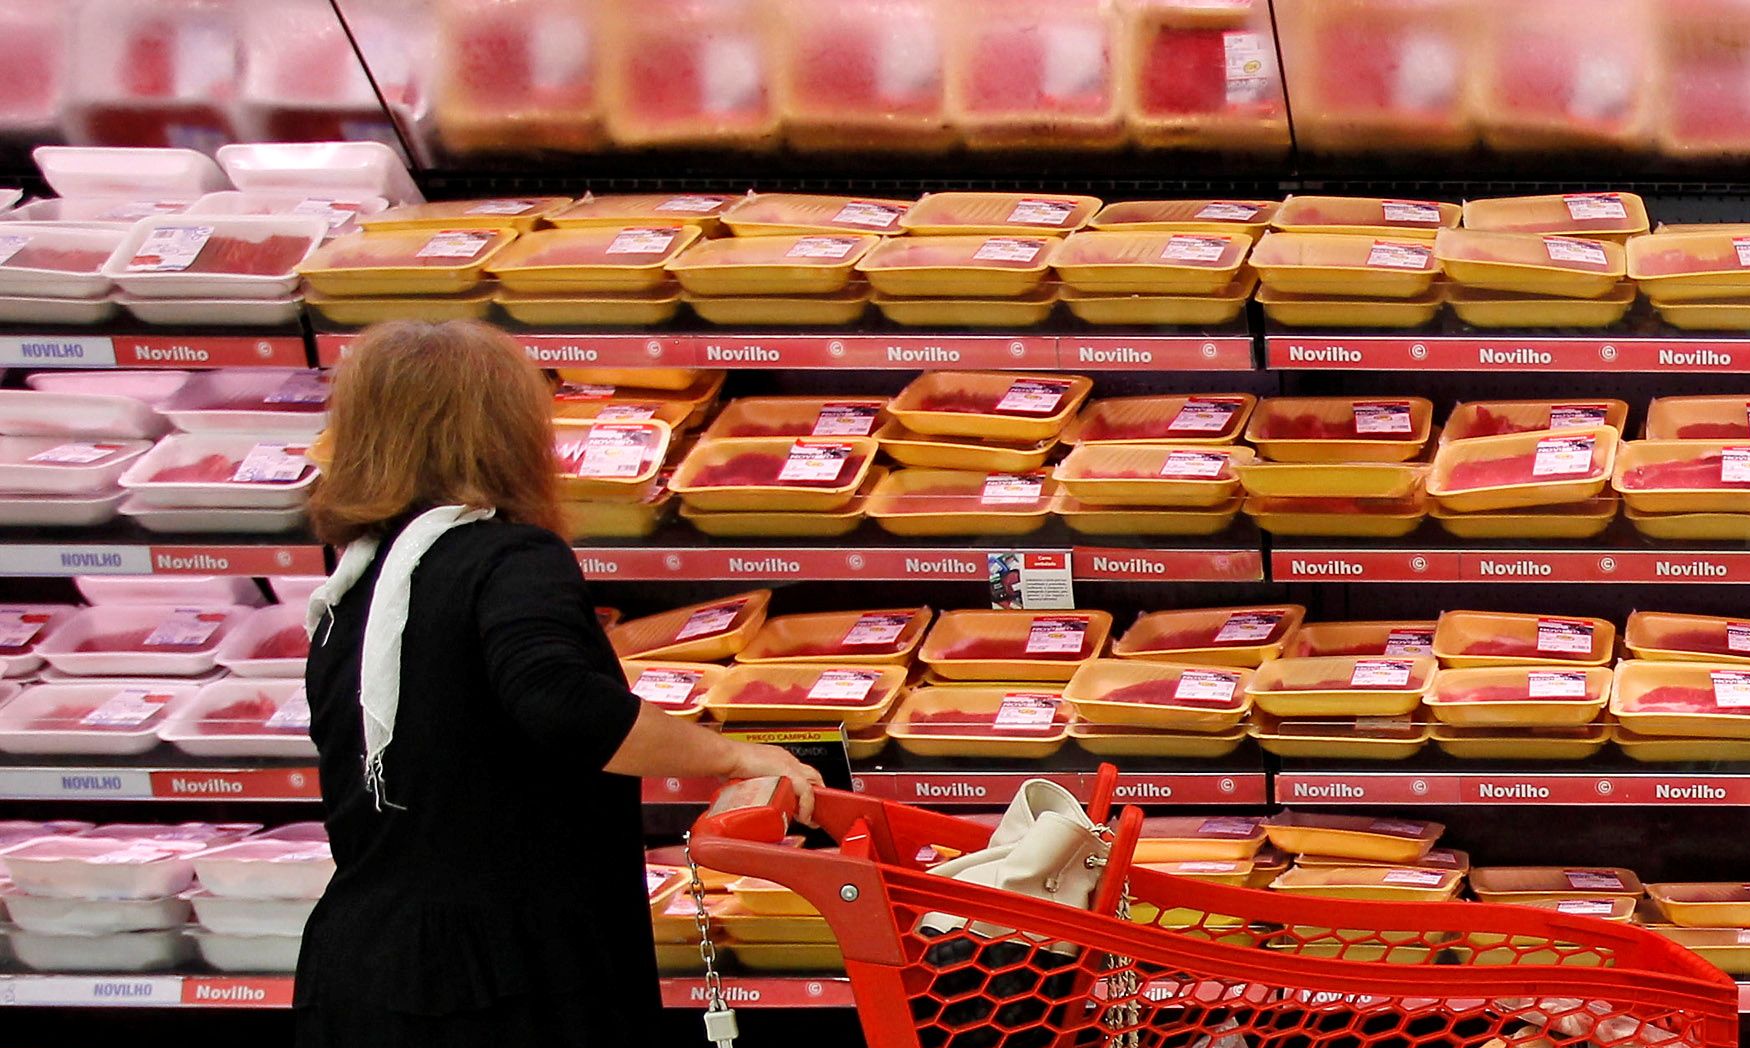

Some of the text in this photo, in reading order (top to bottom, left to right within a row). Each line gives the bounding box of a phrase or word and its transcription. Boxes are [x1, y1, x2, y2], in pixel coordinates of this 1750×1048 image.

[21, 343, 83, 357] NOVILHO
[135, 345, 209, 361] Novilho
[525, 345, 597, 361] Novilho
[707, 345, 779, 361] Novilho
[887, 346, 960, 362] Novilho
[1079, 347, 1152, 363] Novilho
[1289, 346, 1362, 362] Novilho
[1479, 348, 1552, 364] Novilho
[1659, 349, 1732, 365] Novilho
[61, 553, 121, 567] NOVILHO
[157, 554, 229, 570] Novilho
[729, 558, 800, 572] Novilho
[905, 558, 977, 573] Novilho
[1093, 557, 1165, 574] Novilho
[1291, 560, 1363, 575] Novilho
[1480, 560, 1552, 576] Novilho
[1656, 561, 1727, 576] Novilho
[62, 776, 122, 790] NOVILHO
[172, 779, 243, 793] Novilho
[915, 782, 986, 797] Novilho
[1112, 783, 1172, 797] ovilho
[1294, 783, 1364, 798] Novilho
[1479, 783, 1550, 798] Novilho
[1656, 784, 1726, 799] Novilho
[94, 983, 152, 996] NOVILHO
[196, 985, 265, 1000] Novilho
